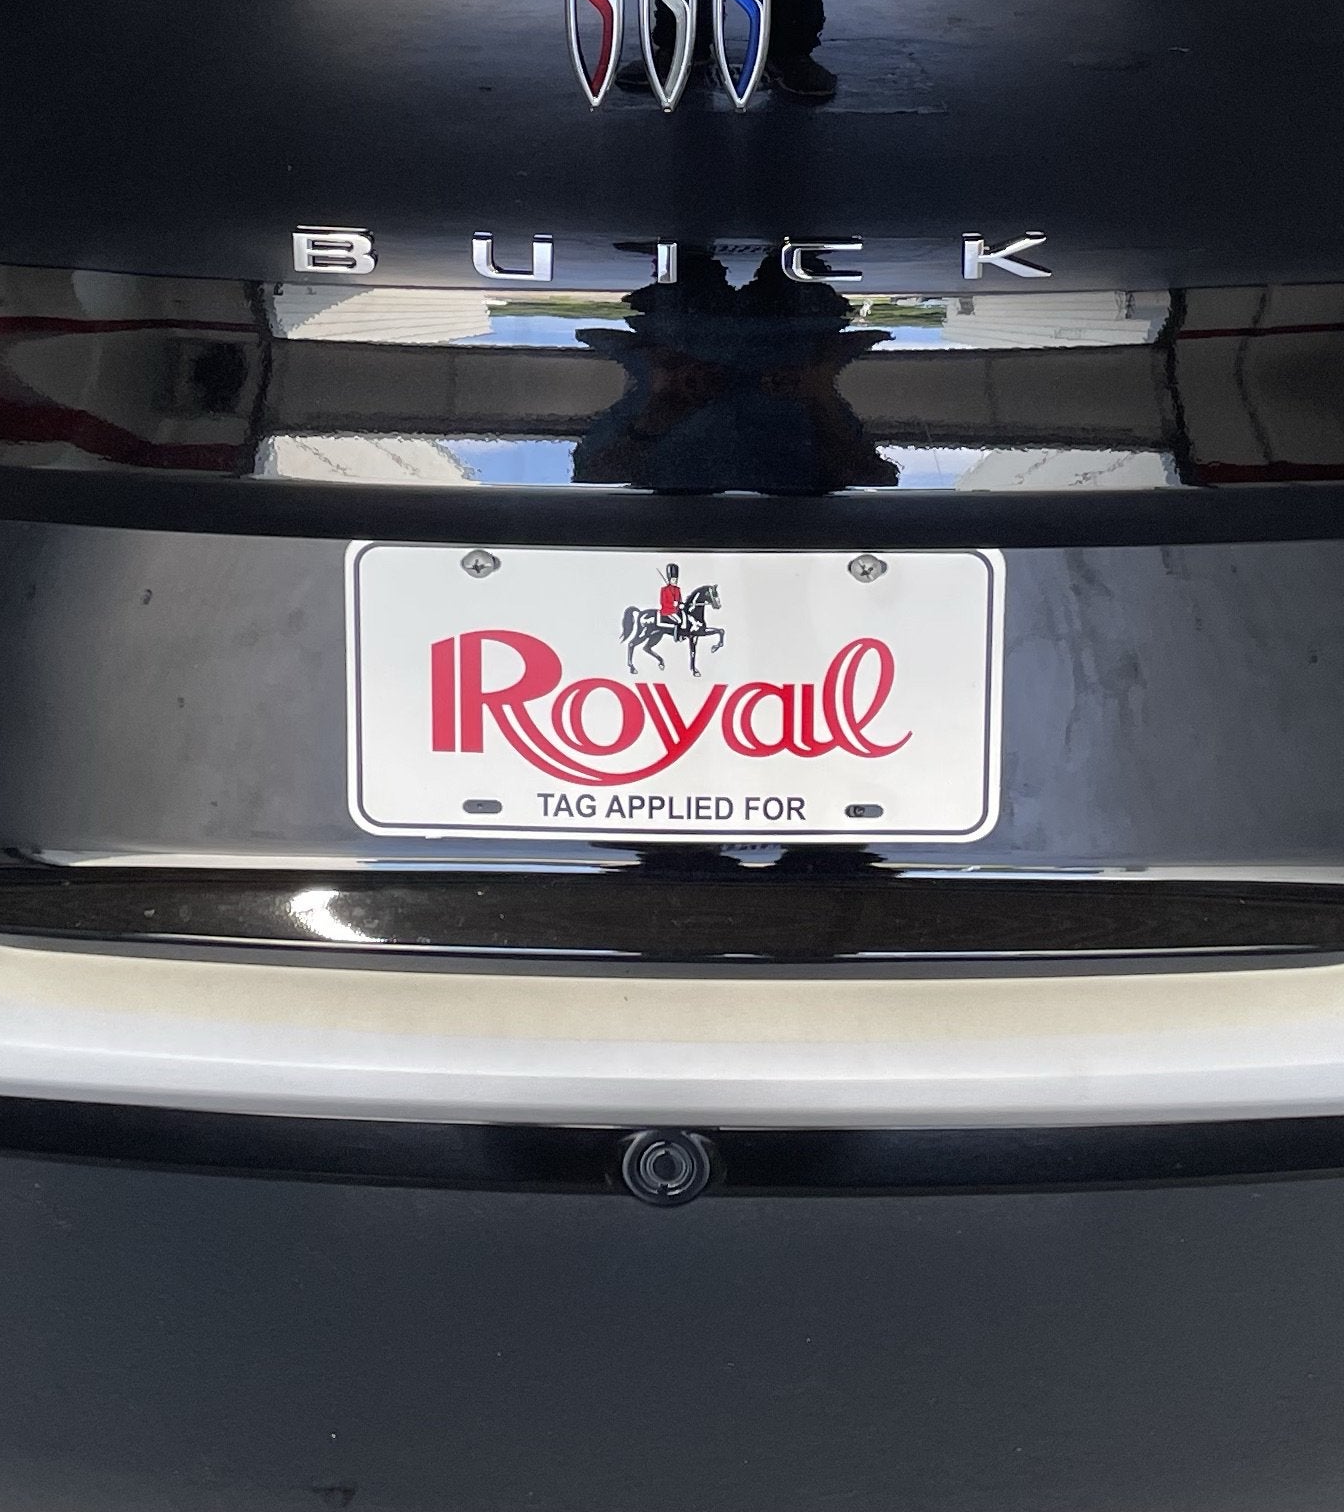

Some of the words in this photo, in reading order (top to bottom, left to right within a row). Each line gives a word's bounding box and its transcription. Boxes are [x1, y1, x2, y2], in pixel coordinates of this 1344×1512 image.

[292, 225, 1053, 284] BUICK
[431, 629, 913, 786] Royal
[537, 792, 597, 819] TAG
[605, 794, 735, 821] APPLIED
[744, 796, 806, 821] FOR
